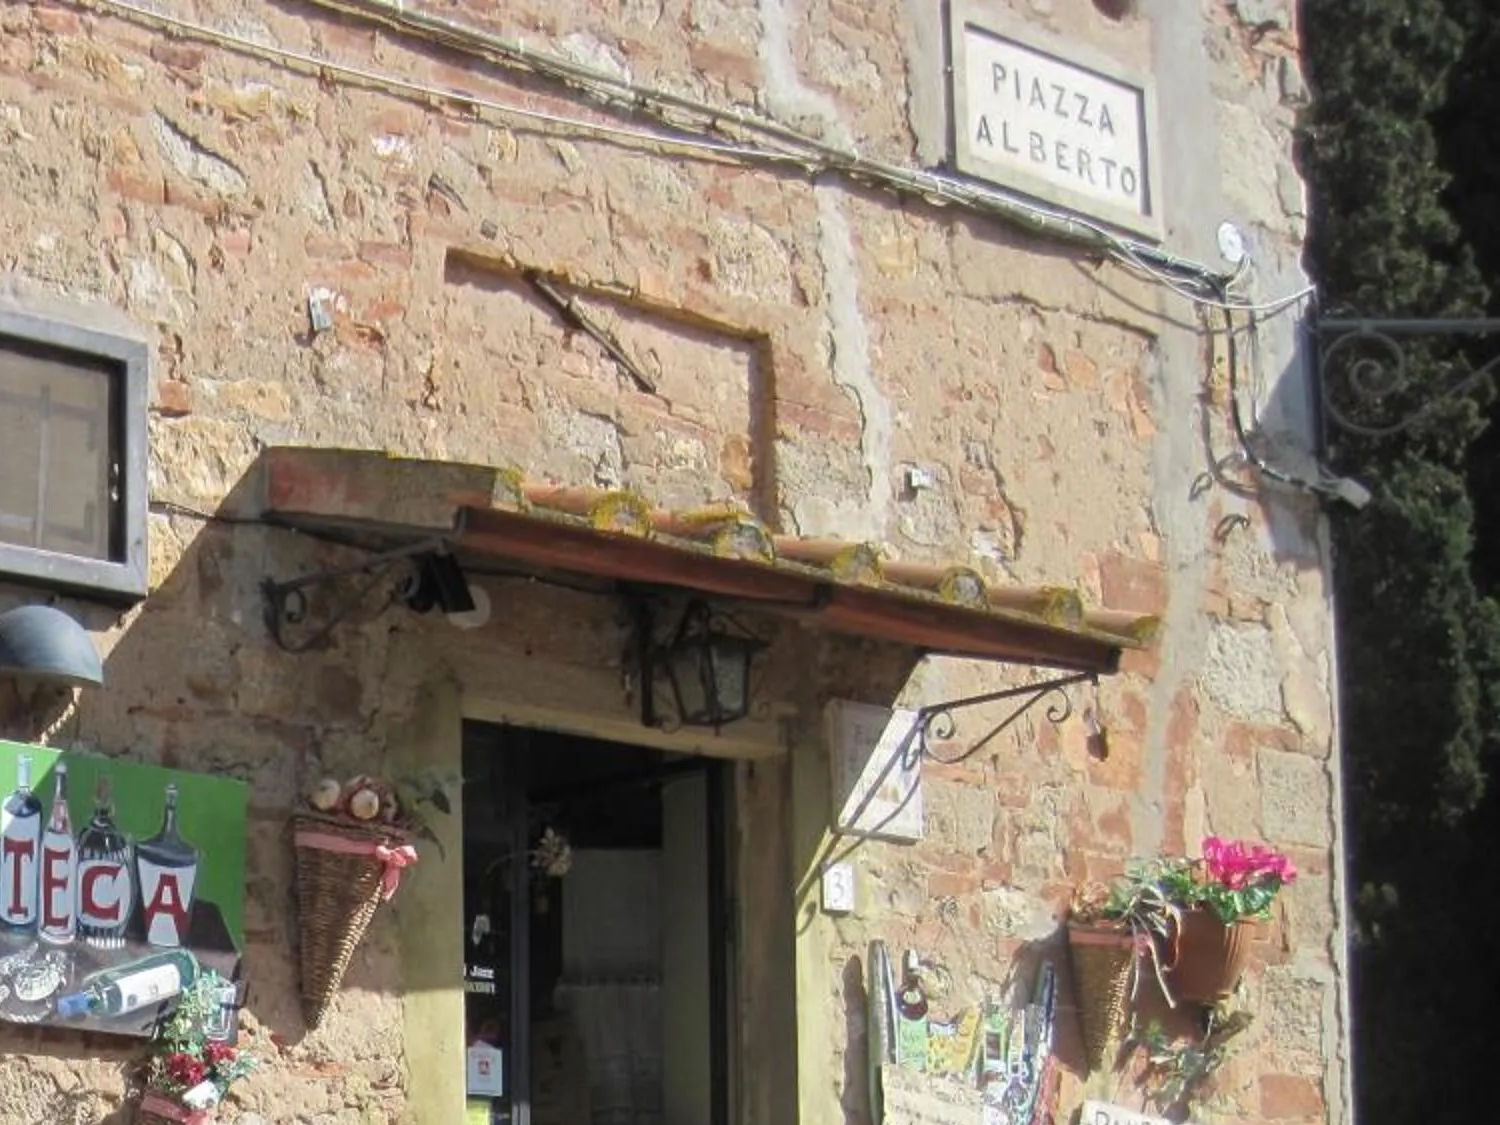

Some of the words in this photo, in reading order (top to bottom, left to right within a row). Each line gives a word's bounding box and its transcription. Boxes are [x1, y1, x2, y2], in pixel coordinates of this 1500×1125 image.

[992, 62, 1115, 137] PIAZZA
[976, 114, 1137, 196] ALBERTO
[831, 870, 846, 905] 3
